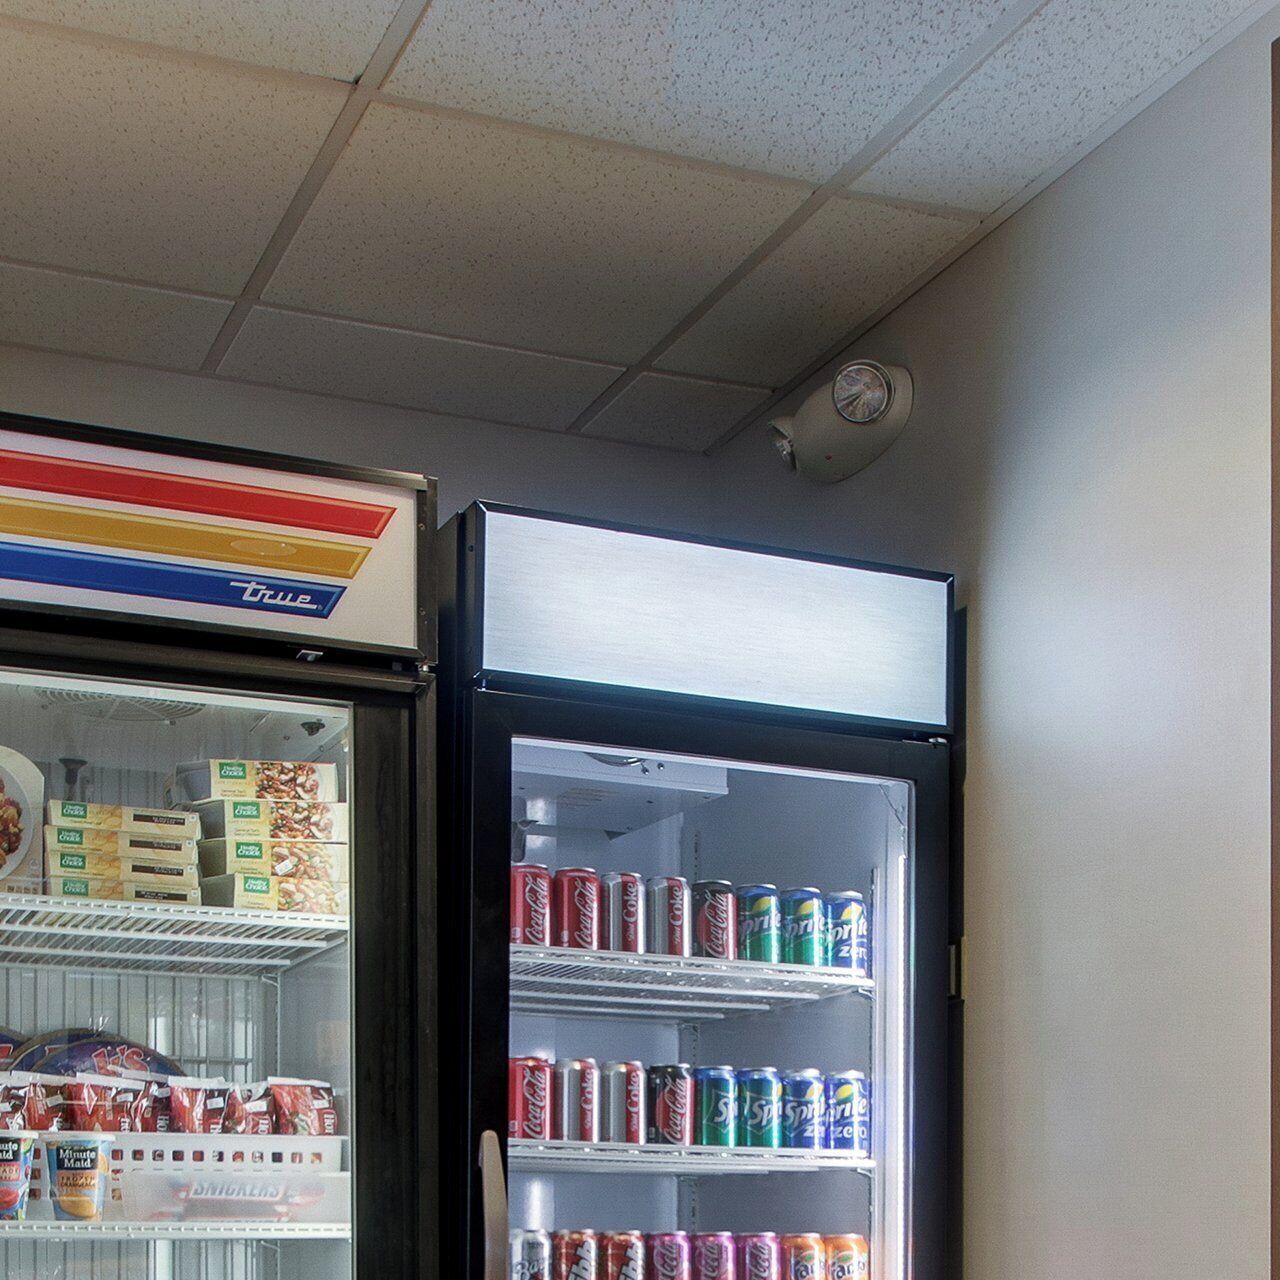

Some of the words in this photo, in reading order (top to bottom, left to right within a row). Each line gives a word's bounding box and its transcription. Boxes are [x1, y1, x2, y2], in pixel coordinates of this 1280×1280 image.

[230, 580, 323, 610] true
[246, 883, 268, 891] Choice
[623, 881, 637, 923] Coke
[668, 881, 683, 925] Coke
[581, 1068, 593, 1111] Coke
[626, 1070, 640, 1114] Coke
[59, 1149, 96, 1159] Minute
[64, 1158, 91, 1168] Maid
